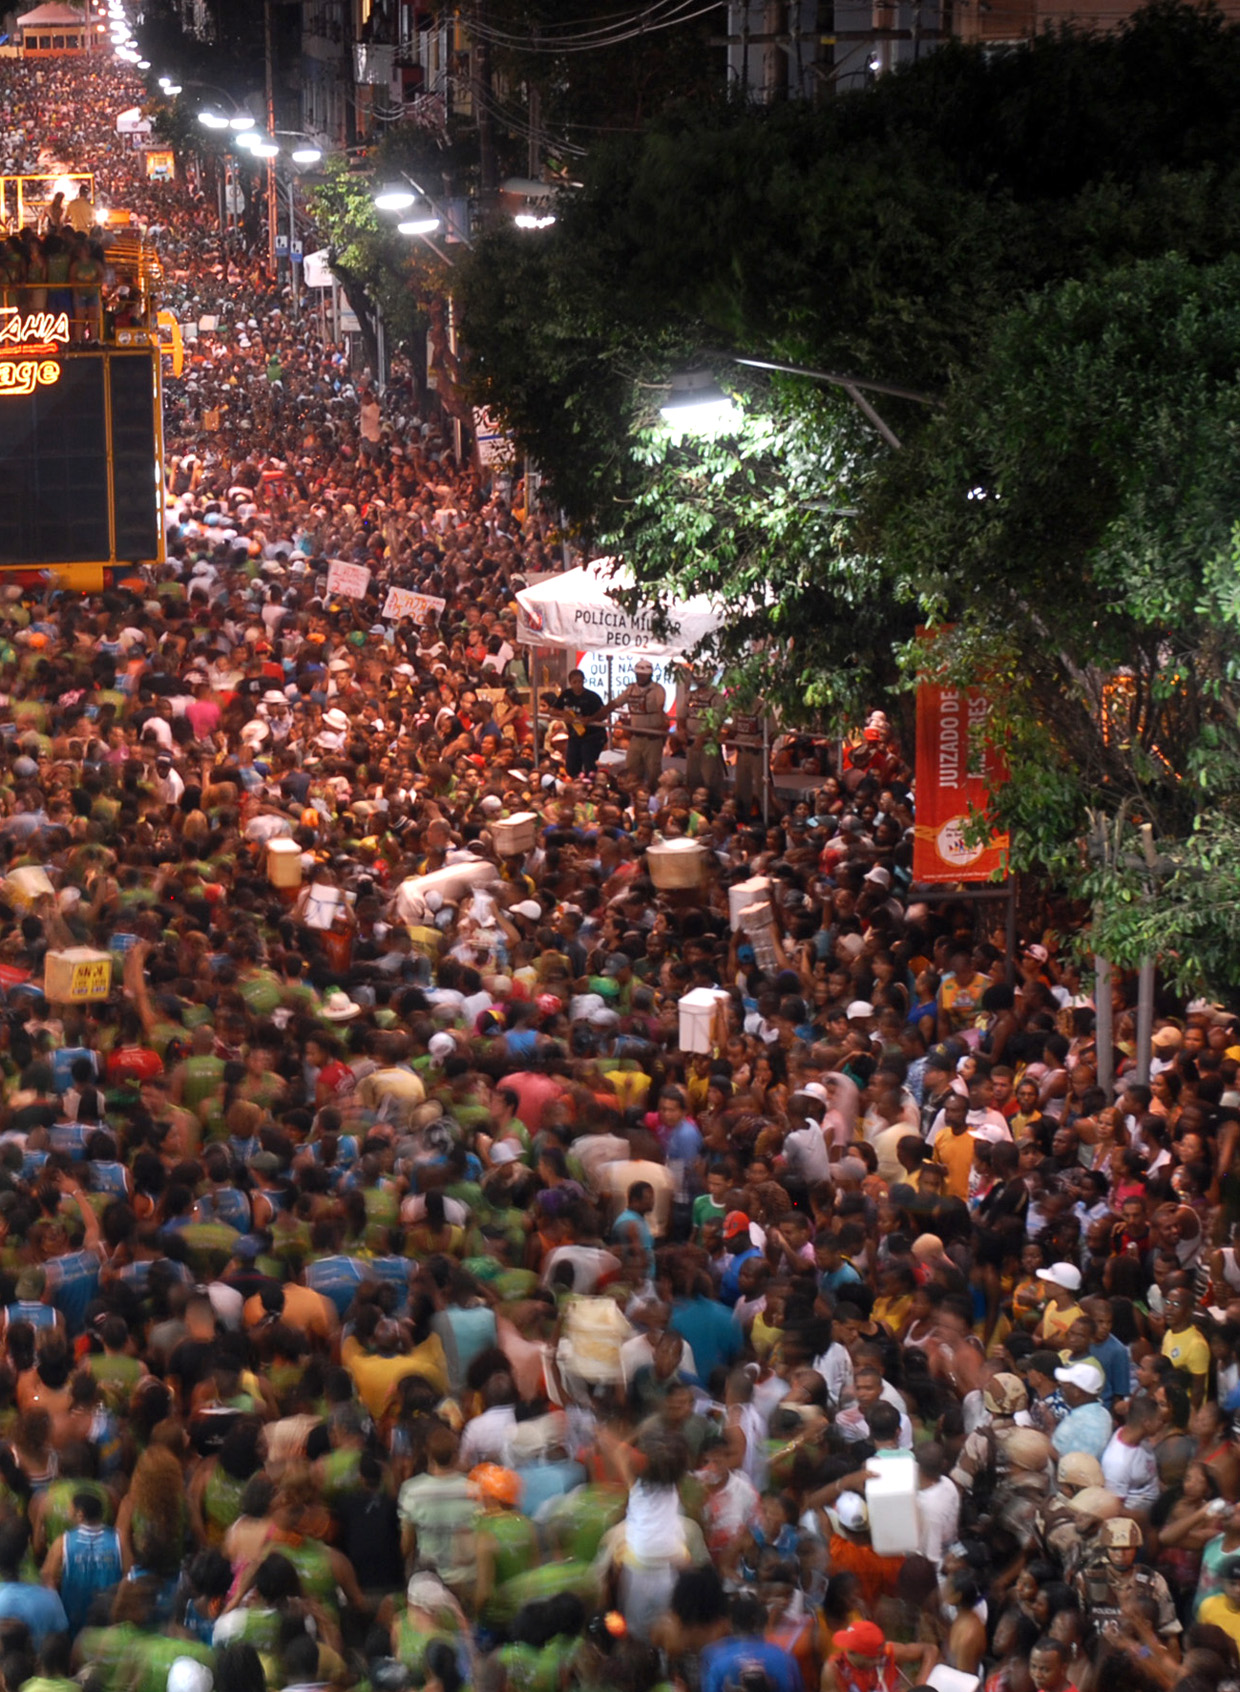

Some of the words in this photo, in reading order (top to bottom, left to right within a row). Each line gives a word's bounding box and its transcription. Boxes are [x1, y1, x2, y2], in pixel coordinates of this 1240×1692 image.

[575, 609, 626, 628] POLÍCIA
[630, 611, 682, 635] MÍLAR
[606, 631, 631, 646] PEO
[635, 634, 649, 649] 02
[941, 691, 959, 712] DE
[939, 716, 959, 790] JUIZADO
